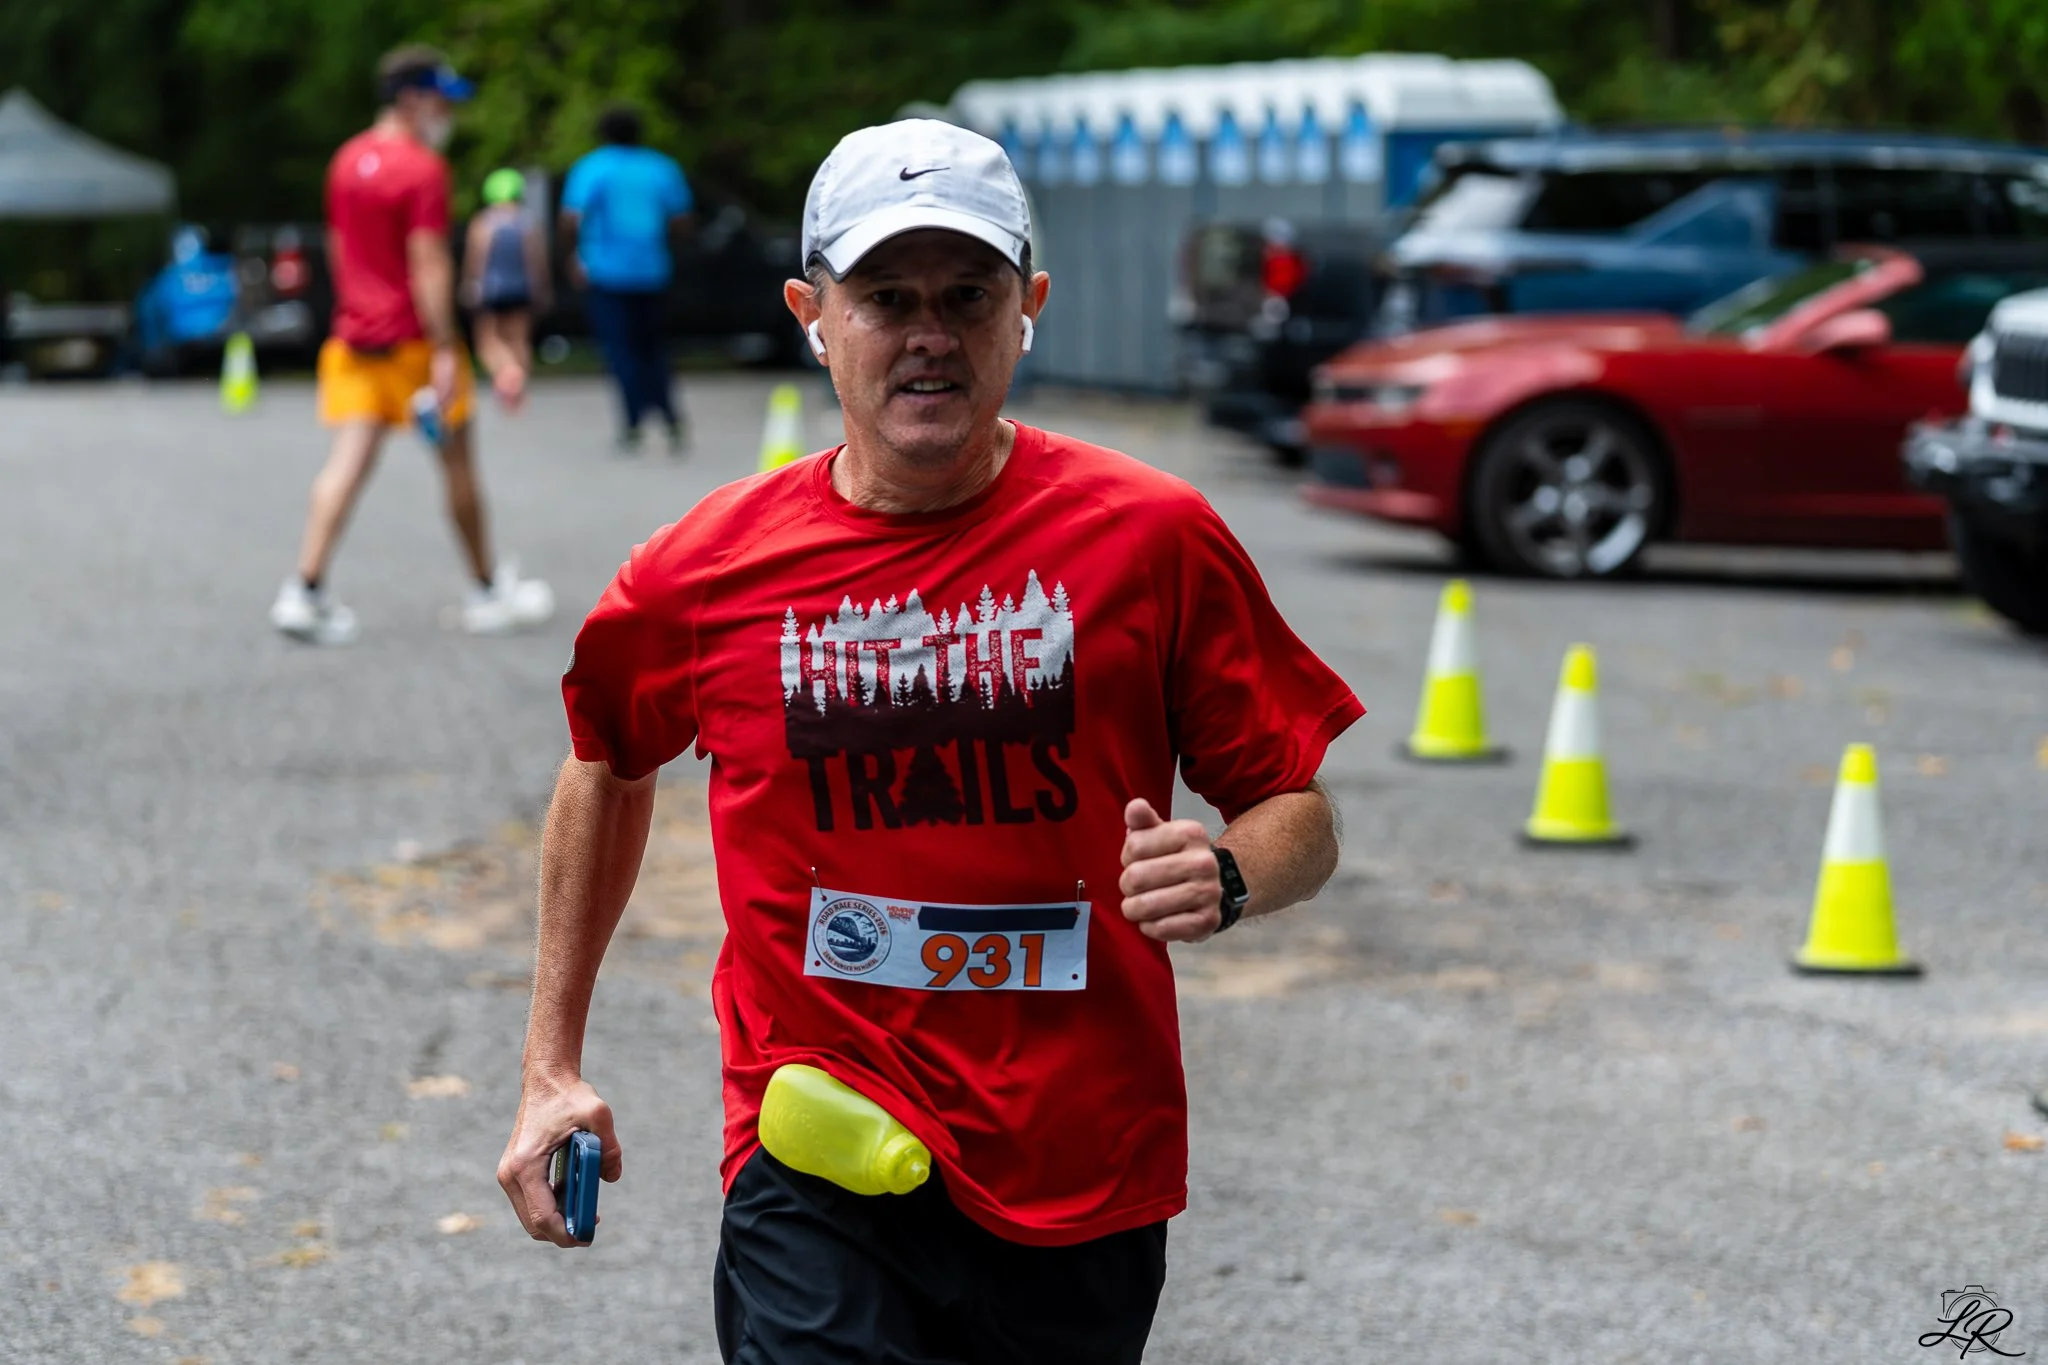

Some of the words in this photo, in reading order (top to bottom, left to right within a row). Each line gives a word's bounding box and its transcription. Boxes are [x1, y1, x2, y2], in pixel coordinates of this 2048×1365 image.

[800, 638, 901, 706] HIT
[922, 628, 1042, 708] THE
[791, 732, 1078, 831] TRAILS
[818, 907, 834, 925] ROAD
[834, 901, 852, 911] RACE
[854, 902, 876, 917] SERIES
[921, 933, 1045, 988] 931
